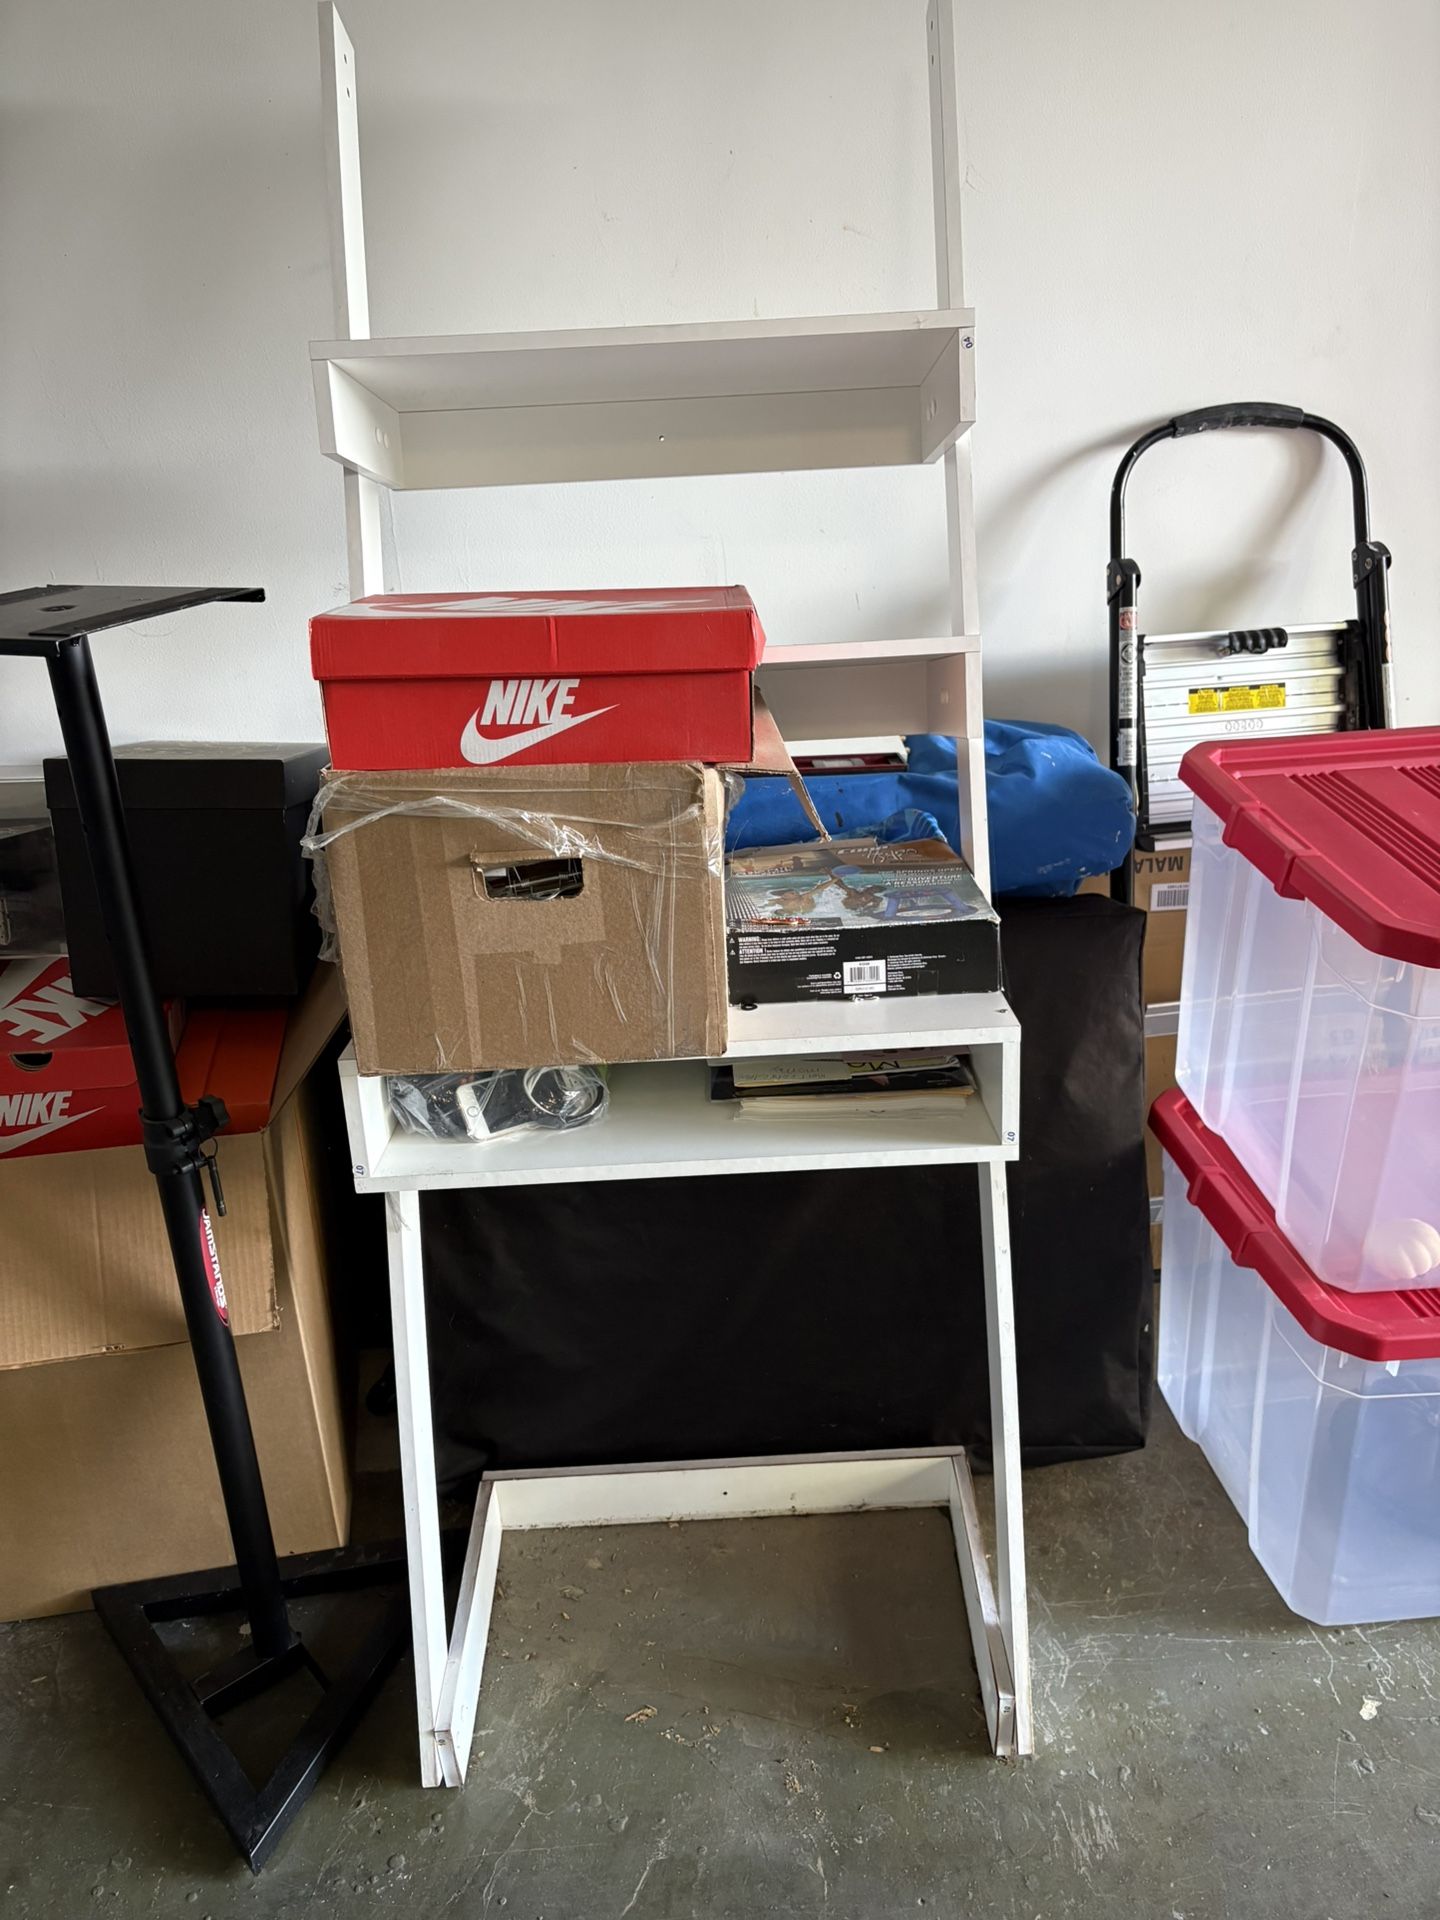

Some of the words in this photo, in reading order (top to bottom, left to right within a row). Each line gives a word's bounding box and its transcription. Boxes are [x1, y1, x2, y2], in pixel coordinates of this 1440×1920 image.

[480, 679, 580, 726] NIKE
[0, 1091, 73, 1127] NIKE
[355, 1164, 365, 1176] 07
